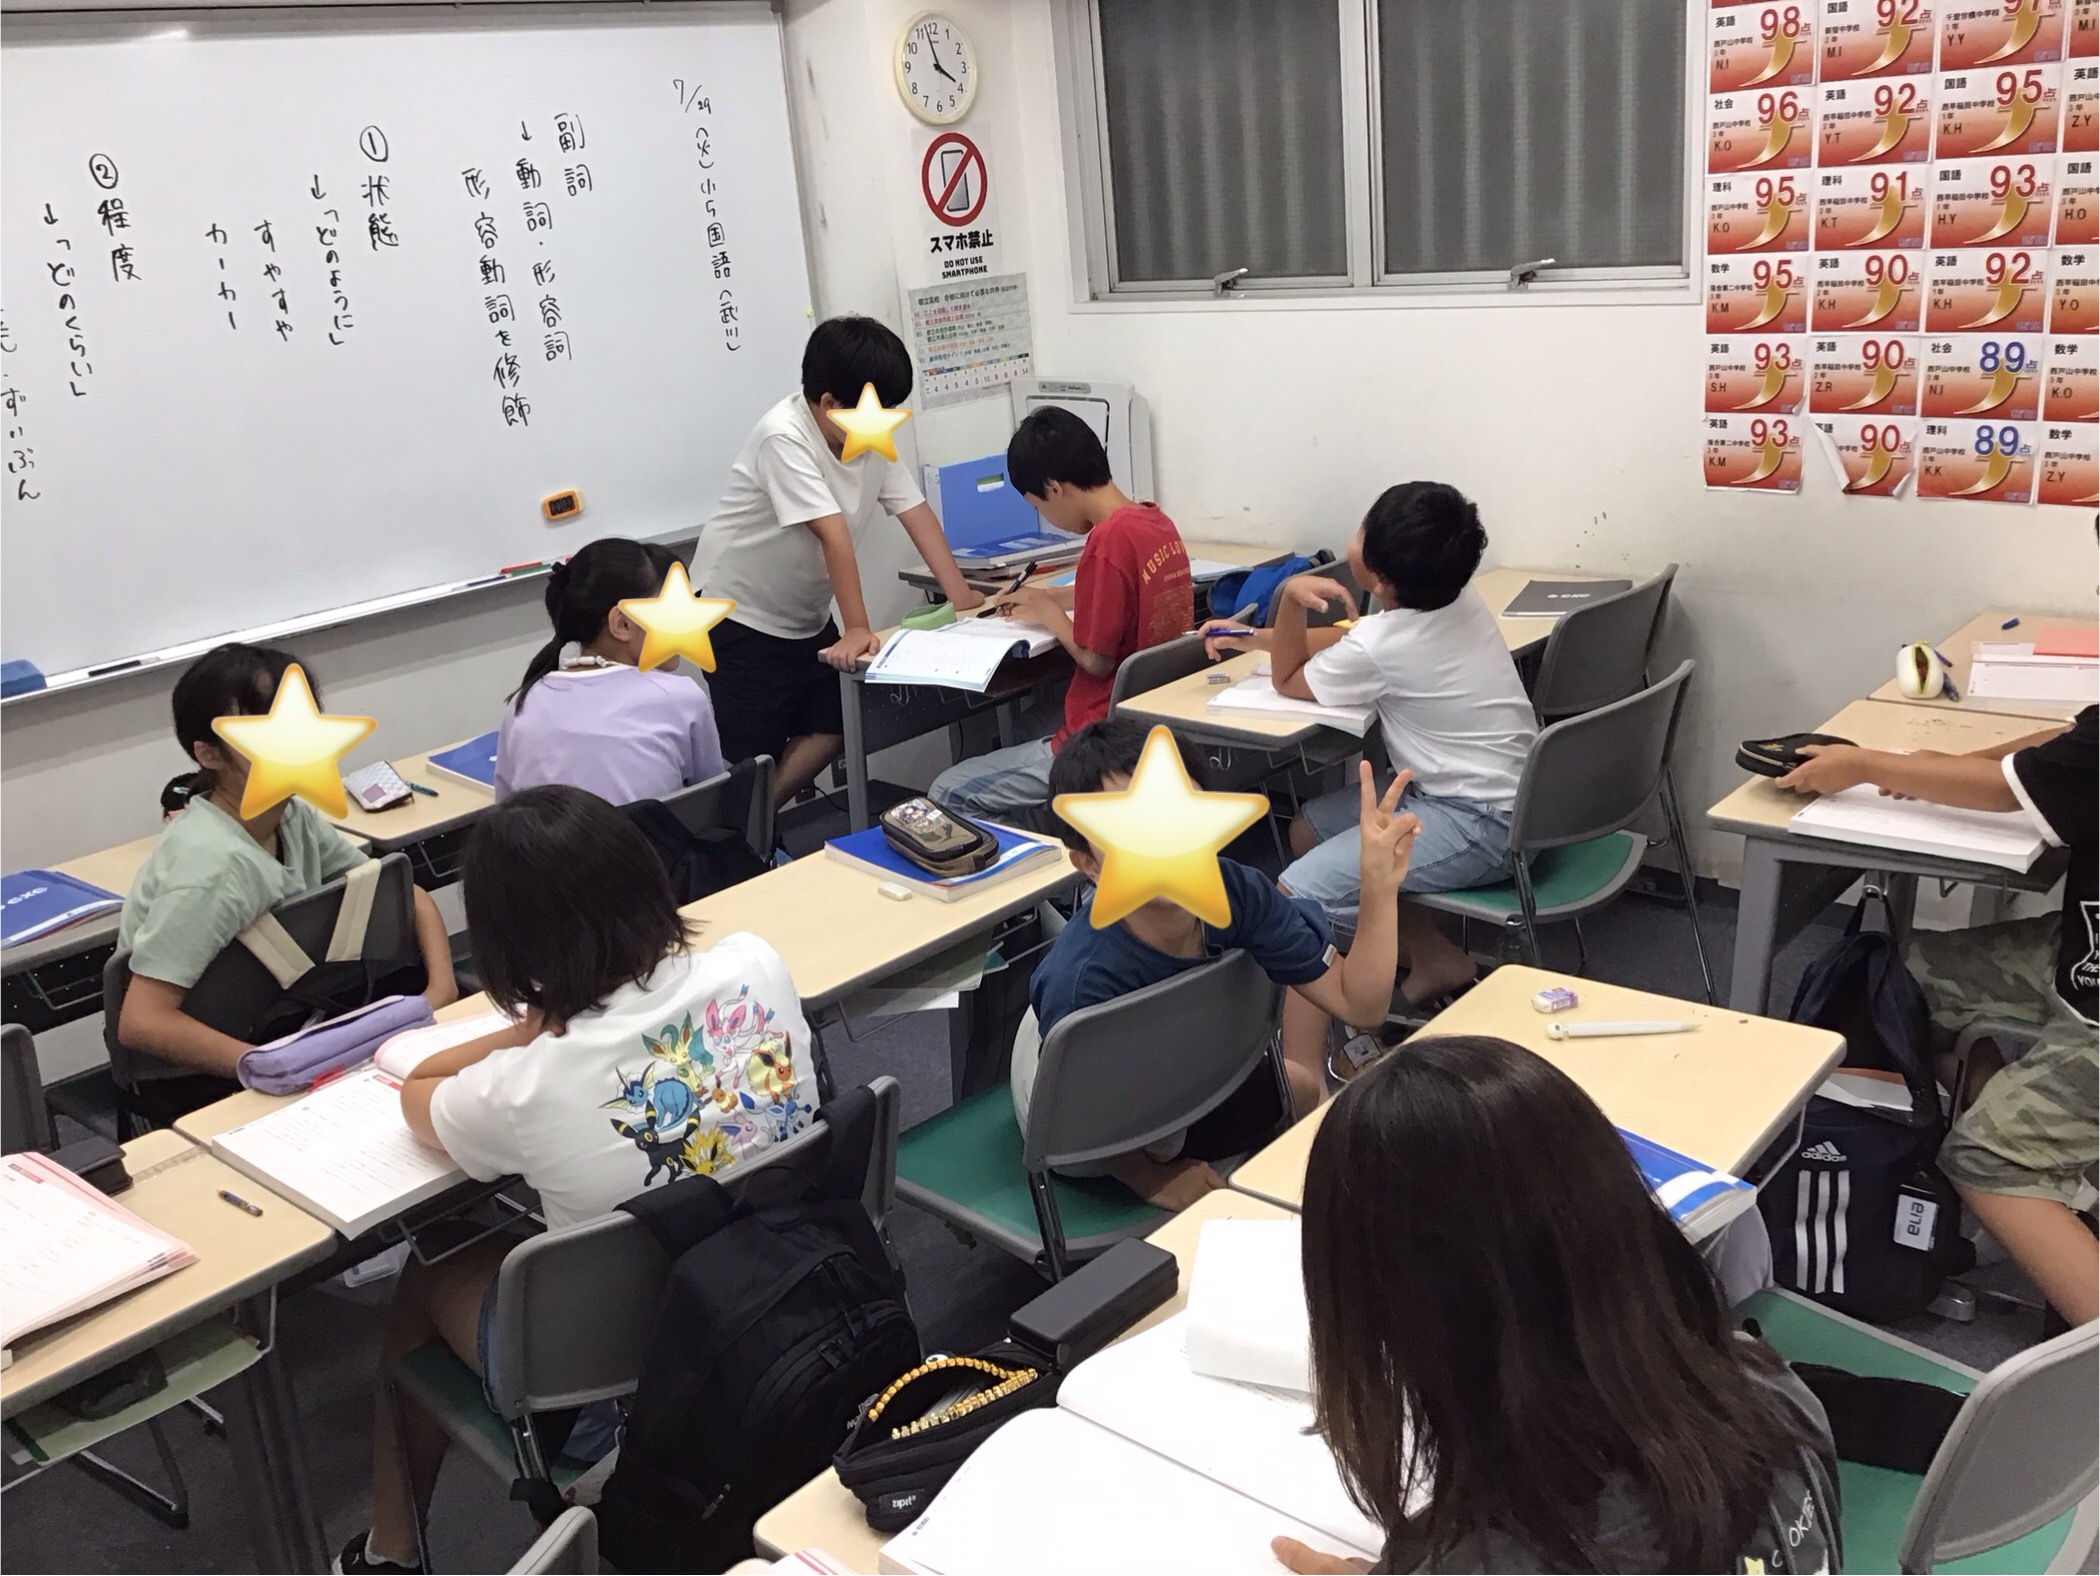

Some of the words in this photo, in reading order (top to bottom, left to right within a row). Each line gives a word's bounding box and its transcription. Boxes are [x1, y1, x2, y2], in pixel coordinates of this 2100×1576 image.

[1827, 1, 1848, 14] 国語
[1715, 15, 1736, 28] 英語
[915, 28, 924, 40] 11
[928, 22, 939, 35] 12
[945, 28, 950, 40] 1
[907, 41, 918, 55] 10
[955, 42, 962, 55] 2
[904, 61, 911, 73] 9
[961, 61, 967, 74] 3
[2074, 67, 2099, 80] 英語
[911, 82, 918, 94] 8
[957, 82, 964, 94] 4
[1944, 77, 1967, 90] 国語
[922, 95, 930, 107] 7
[949, 95, 956, 107] 5
[1825, 89, 1846, 101] 英語
[936, 100, 943, 112] 6
[1714, 98, 1734, 110] 社会
[553, 111, 593, 198] 副詞
[2067, 162, 2092, 175] 国語
[1821, 175, 1842, 186] 理科
[1939, 169, 1961, 182] 国語
[1712, 181, 1731, 192] 理科
[929, 228, 994, 254] スマホ禁止
[944, 260, 954, 268] DO
[955, 257, 969, 267] NOT
[970, 255, 983, 265] USE
[1819, 258, 1839, 269] 英語
[1935, 255, 1957, 267] 英語
[2061, 254, 2085, 266] 数学
[942, 265, 988, 279] SMARTPHONE
[1711, 263, 1730, 274] 数学
[253, 218, 293, 343] すやすや
[1710, 343, 1729, 354] 英語
[1816, 341, 1837, 352] 英語
[1931, 342, 1952, 354] 社会
[2055, 344, 2078, 355] 数学
[1709, 418, 1728, 429] 英語
[1926, 425, 1947, 436] 理科
[2049, 429, 2072, 440] 数学
[1142, 545, 1170, 586] MUSIC
[1801, 1151, 1847, 1162] adidas
[1907, 1201, 1925, 1236] ena
